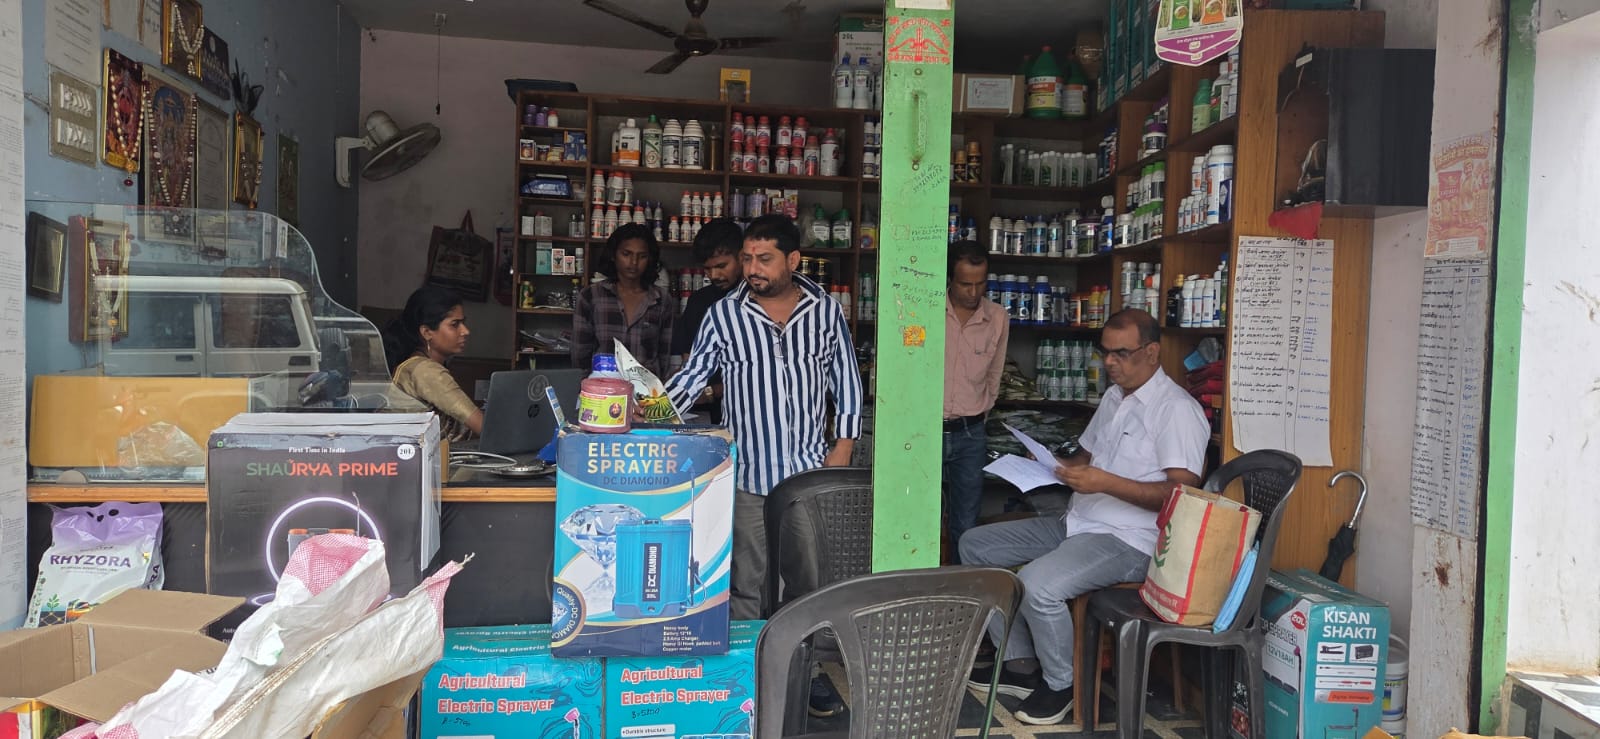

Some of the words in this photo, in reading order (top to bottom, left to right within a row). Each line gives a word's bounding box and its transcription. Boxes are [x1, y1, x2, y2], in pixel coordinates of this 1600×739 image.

[588, 442, 679, 458] ELECTRIC
[246, 460, 333, 477] SHAURYA
[338, 462, 399, 477] PRIME
[587, 459, 679, 475] SPRAYER
[603, 476, 617, 486] DC
[620, 476, 670, 486] DIAMOND
[50, 554, 131, 568] RHYZORA
[648, 546, 658, 574] DIAMOND
[1291, 613, 1306, 627] 20L
[1324, 610, 1371, 625] KISAN
[1322, 625, 1377, 639] SHAKTI
[438, 672, 526, 691] Agricultural
[621, 664, 703, 684] Agricultural
[621, 690, 674, 706] Electric
[677, 688, 730, 705] Sprayer
[437, 699, 494, 714] Electric
[496, 699, 554, 714] Sprayer
